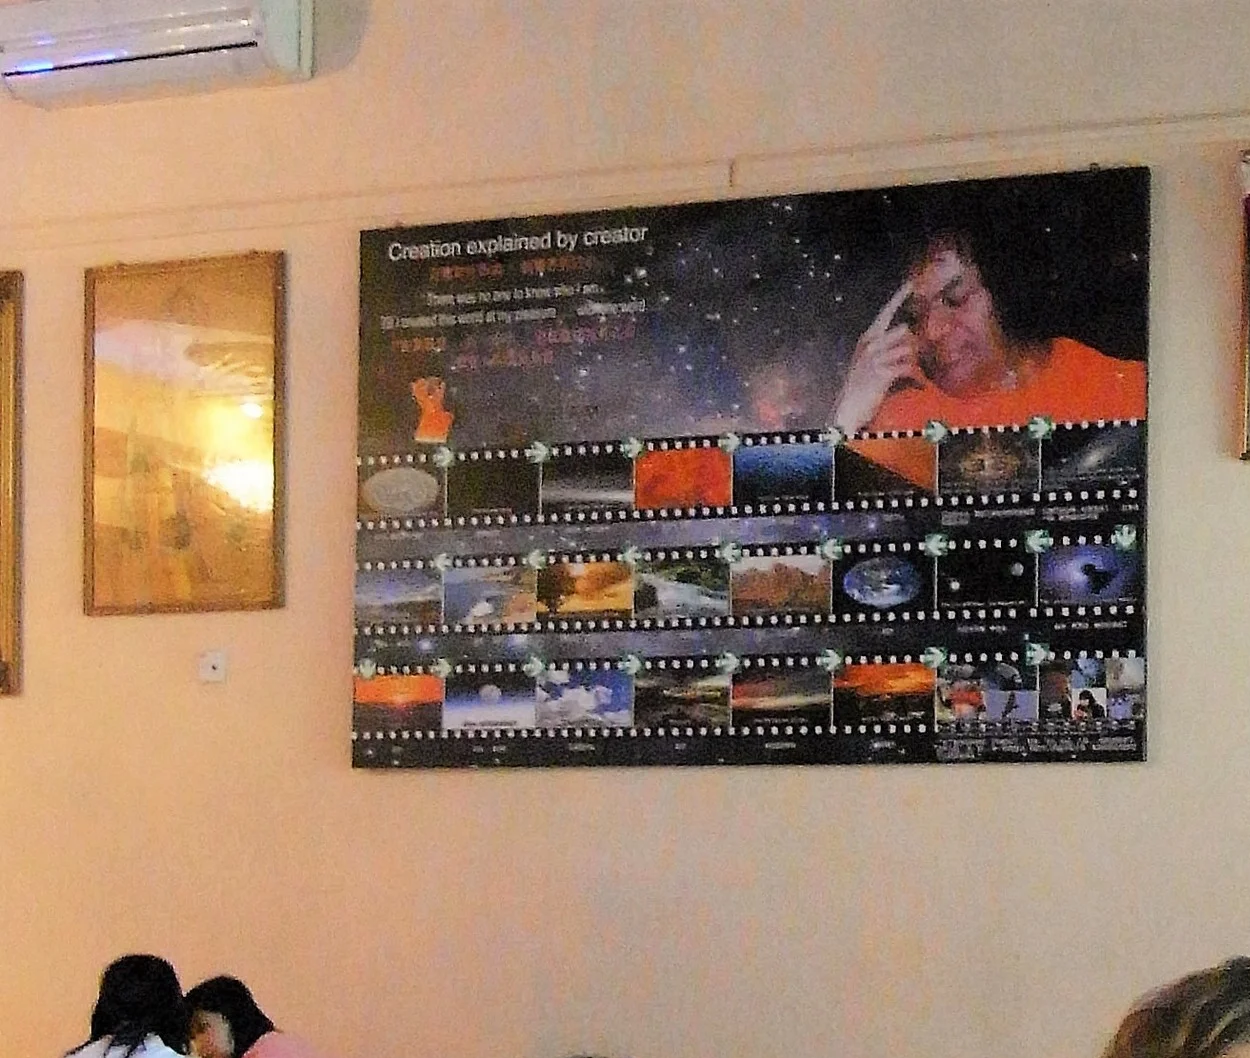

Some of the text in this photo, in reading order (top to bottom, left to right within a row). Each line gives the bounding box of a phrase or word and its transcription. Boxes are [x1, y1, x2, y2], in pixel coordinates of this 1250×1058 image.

[388, 226, 649, 261] Creation explained by creator
